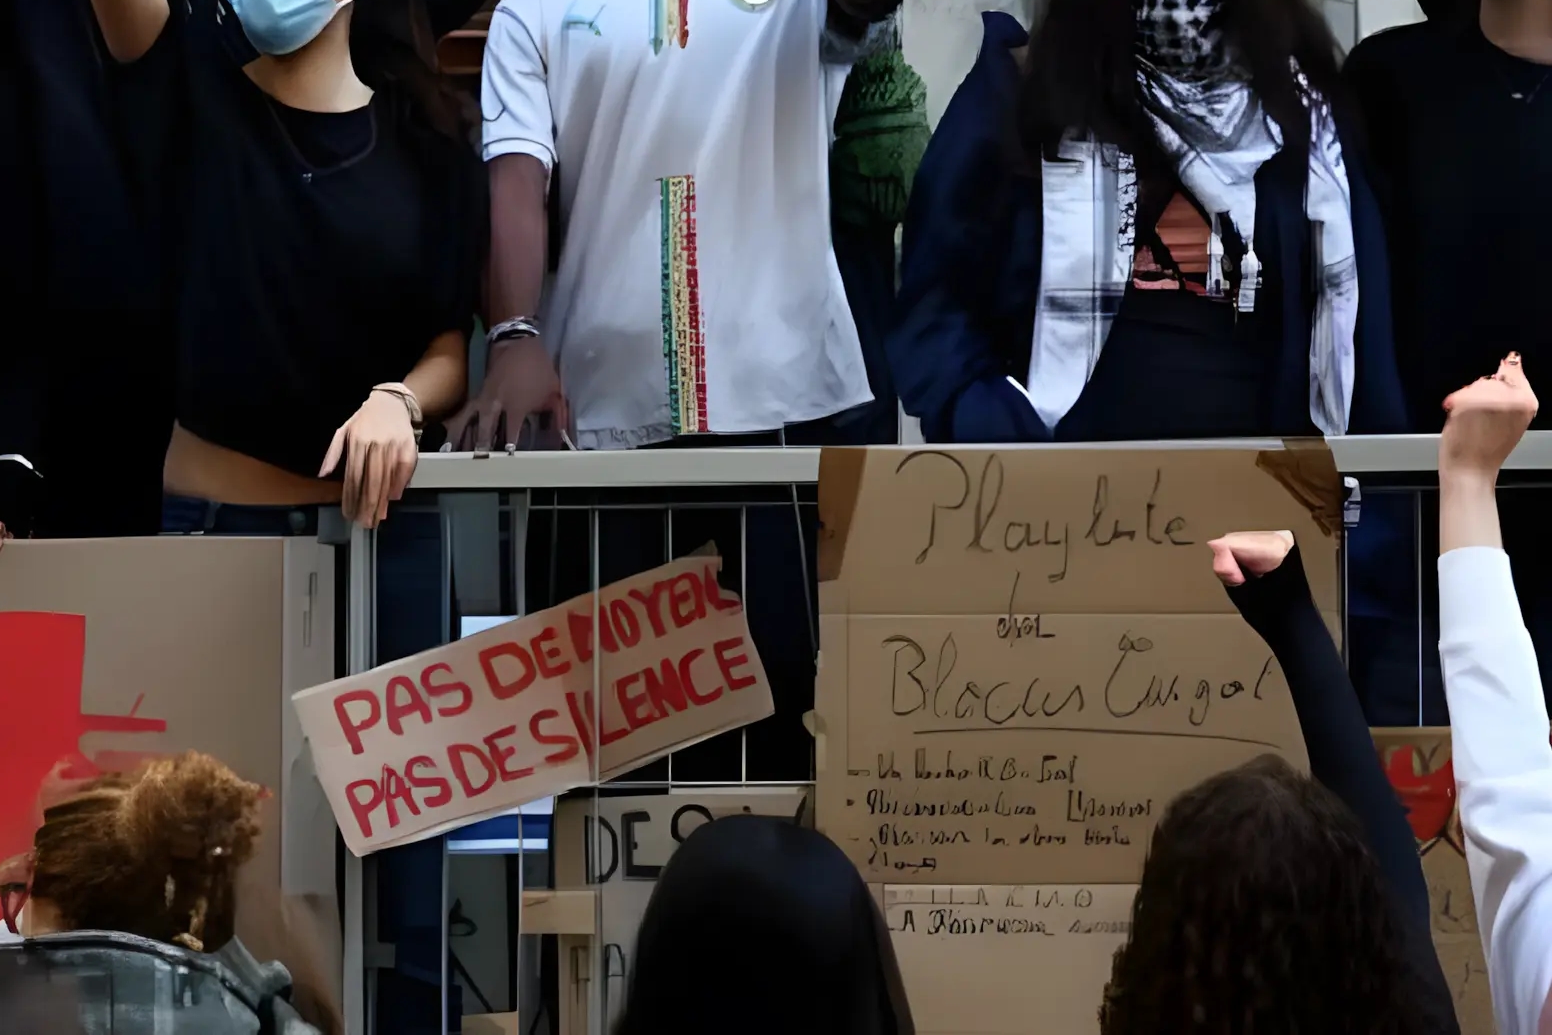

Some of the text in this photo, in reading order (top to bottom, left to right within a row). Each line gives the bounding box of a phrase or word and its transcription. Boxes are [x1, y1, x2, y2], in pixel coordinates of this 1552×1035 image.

[333, 662, 474, 755] PAS
[478, 626, 572, 700] DE
[344, 636, 757, 839] PAS DE SILENCE
